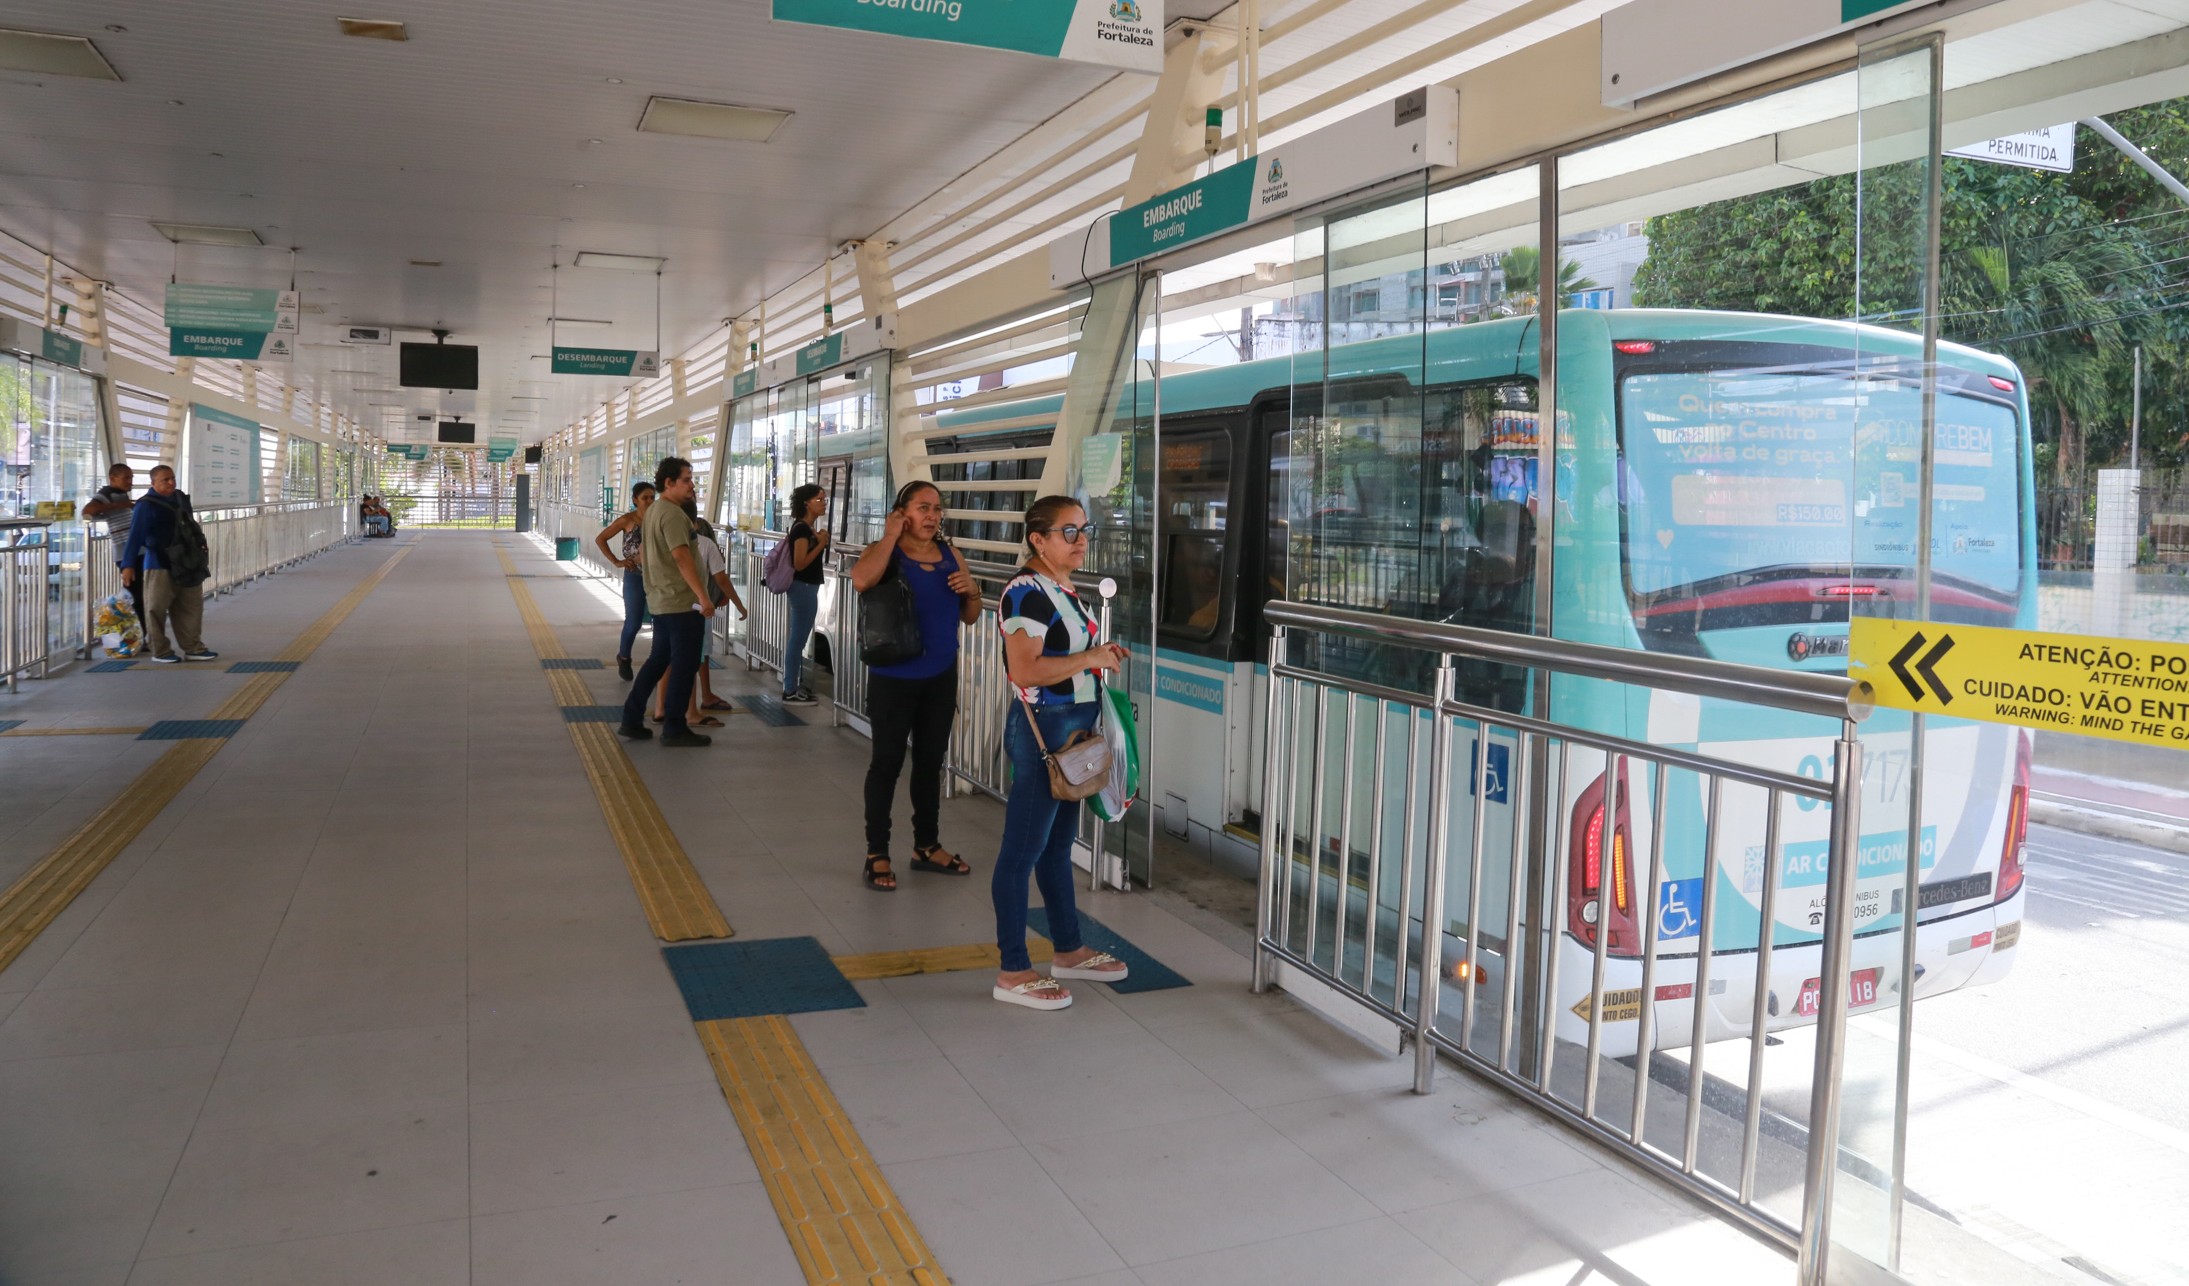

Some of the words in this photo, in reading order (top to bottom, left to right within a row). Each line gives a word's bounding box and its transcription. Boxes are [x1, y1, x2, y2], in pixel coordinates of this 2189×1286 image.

[1097, 21, 1140, 35] Prefeitura
[1142, 26, 1153, 35] de
[1097, 29, 1153, 47] Fortaleza
[1988, 139, 2058, 162] PERMITIDA
[1262, 189, 1288, 205] Fortaleza
[1143, 189, 1203, 228] EMBARQUE
[1153, 221, 1185, 243] Boarding
[183, 335, 244, 346] EMBARQUE
[194, 344, 227, 353] Boarding
[557, 353, 628, 364] DESEMBARQUE
[580, 362, 606, 370] Landing
[1739, 420, 1817, 441] Centro
[1884, 419, 1993, 452] COMREBEM
[1678, 443, 1737, 459] volta
[1742, 443, 1770, 460] de
[1968, 537, 1996, 548] Fortaleza
[2018, 643, 2141, 671] ATENÇÃO:
[2150, 654, 2188, 676] PO
[1160, 675, 1222, 705] CONDICIONADO
[1963, 678, 2072, 708] CUIDADO:
[2080, 689, 2132, 714] VÃO
[1995, 703, 2076, 725] WARNING:
[2080, 714, 2124, 732] MIND
[2130, 720, 2165, 738] THE
[1786, 855, 1812, 876] AR
